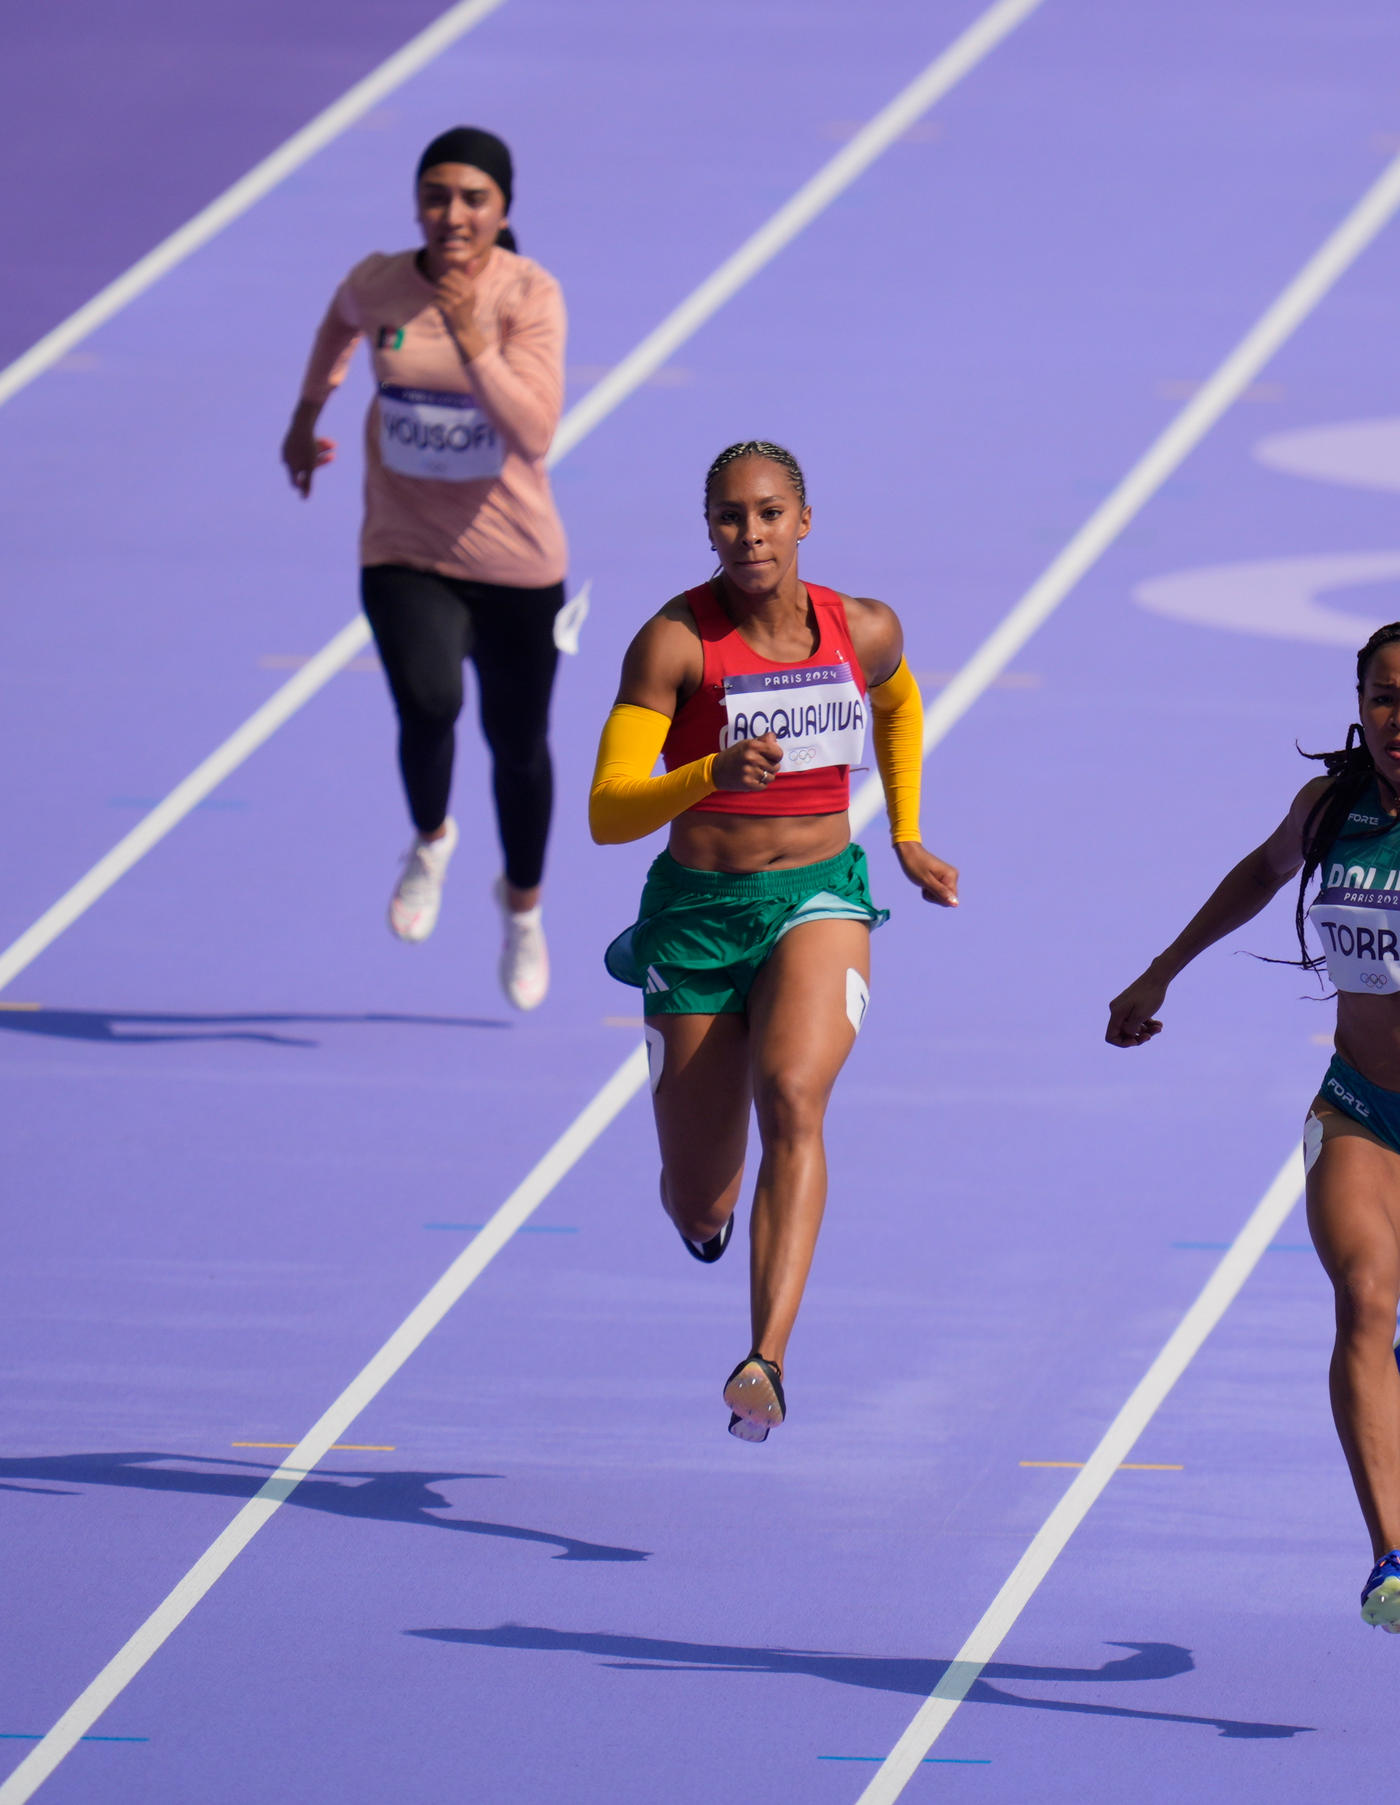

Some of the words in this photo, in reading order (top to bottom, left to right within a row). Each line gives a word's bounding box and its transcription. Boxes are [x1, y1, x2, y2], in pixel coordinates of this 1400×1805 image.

[384, 414, 496, 452] YOUSOFI
[764, 673, 803, 687] PARIS
[805, 669, 838, 683] 2024
[734, 699, 864, 740] ACQUAVIVA
[1343, 892, 1375, 904] PARIS
